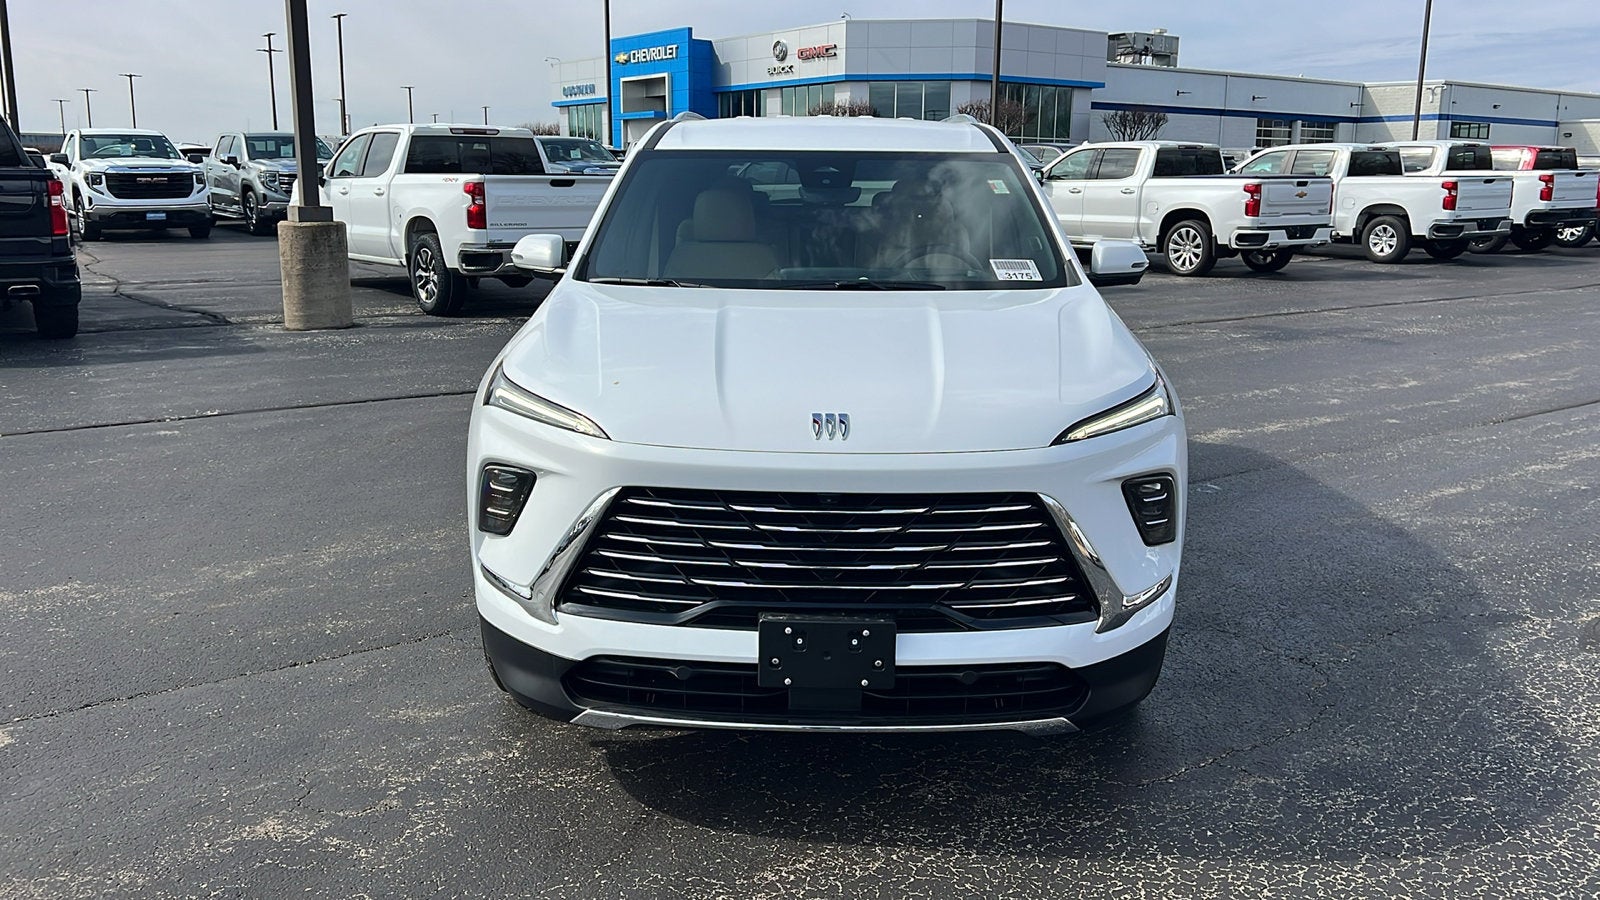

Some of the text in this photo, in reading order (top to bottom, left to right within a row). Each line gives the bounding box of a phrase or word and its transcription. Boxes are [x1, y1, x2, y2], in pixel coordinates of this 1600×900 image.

[630, 44, 678, 64] CHEVROLET
[797, 44, 837, 60] GMC
[767, 65, 794, 75] BUICK
